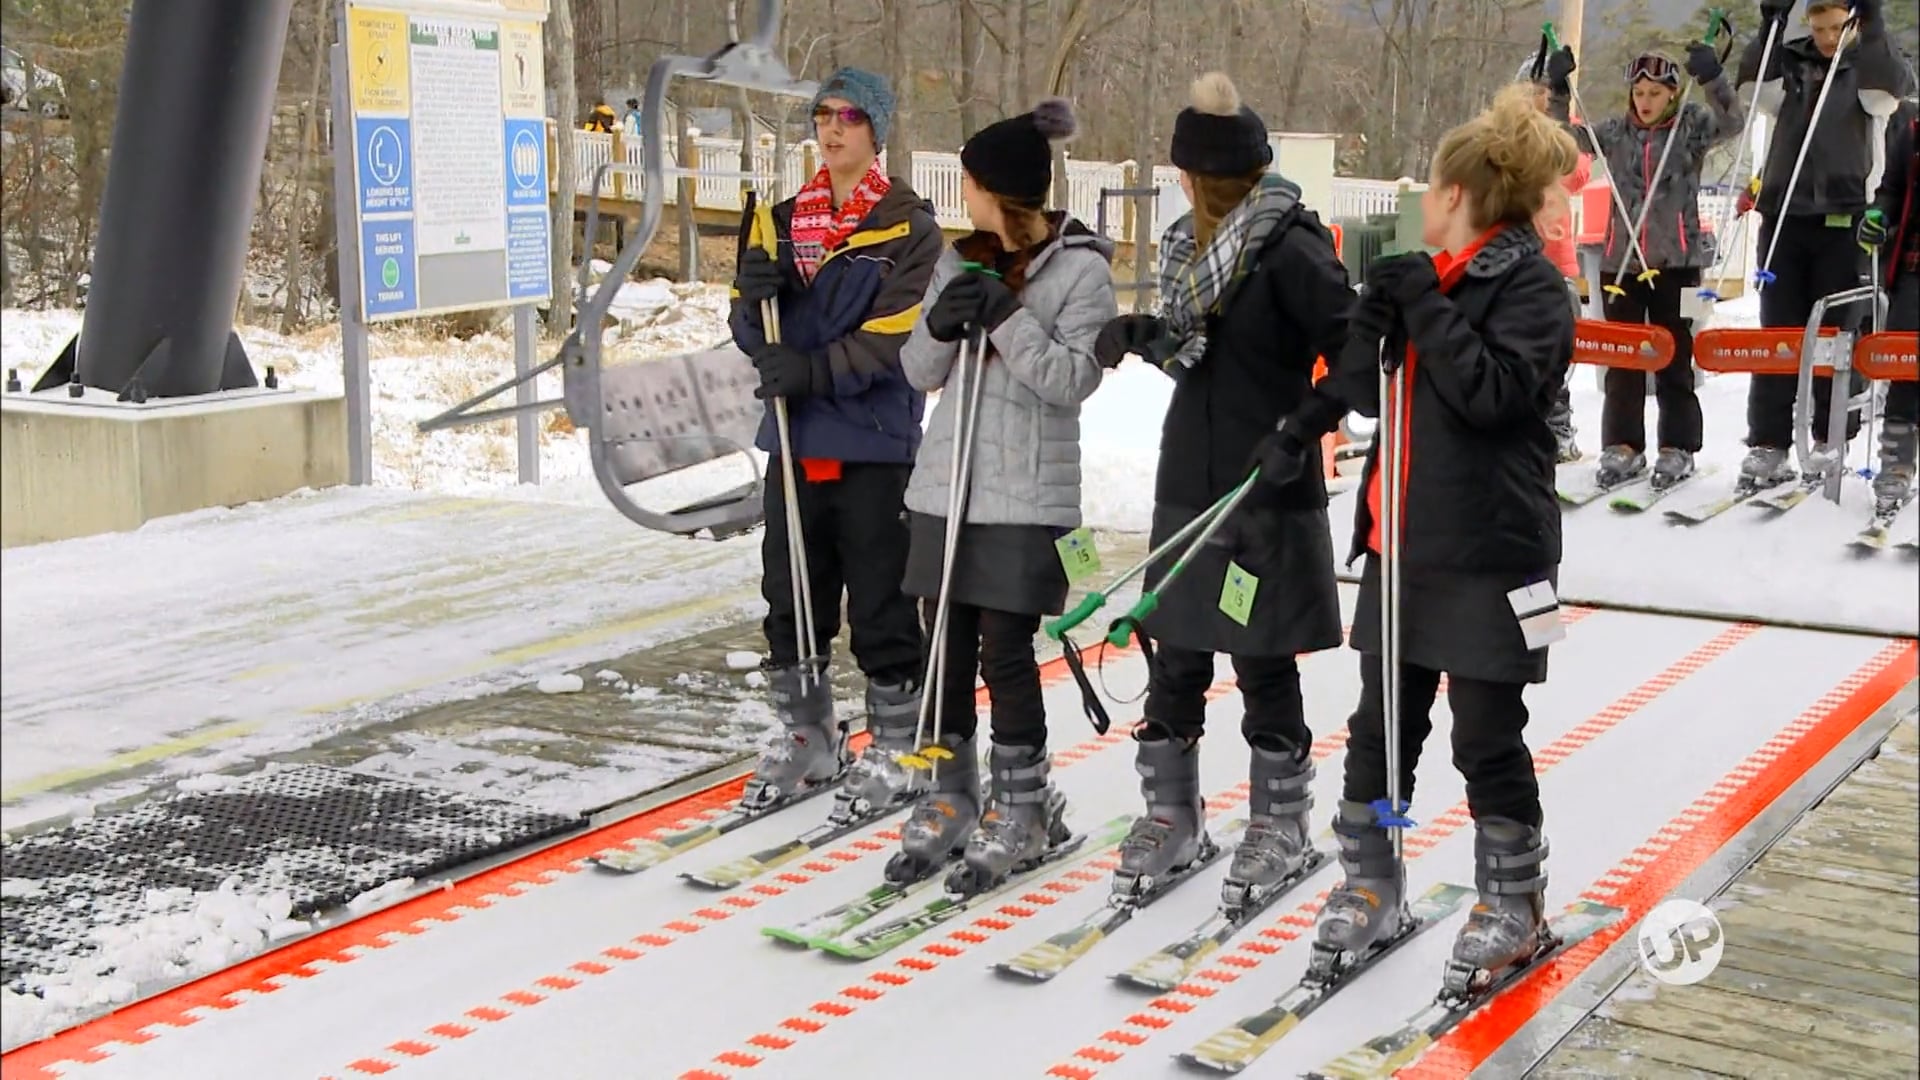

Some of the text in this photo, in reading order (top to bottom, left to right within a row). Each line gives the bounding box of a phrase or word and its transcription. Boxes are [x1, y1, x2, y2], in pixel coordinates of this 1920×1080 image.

[1575, 337, 1635, 355] lean on me
[1733, 348, 1749, 359] on
[1751, 348, 1770, 359] me
